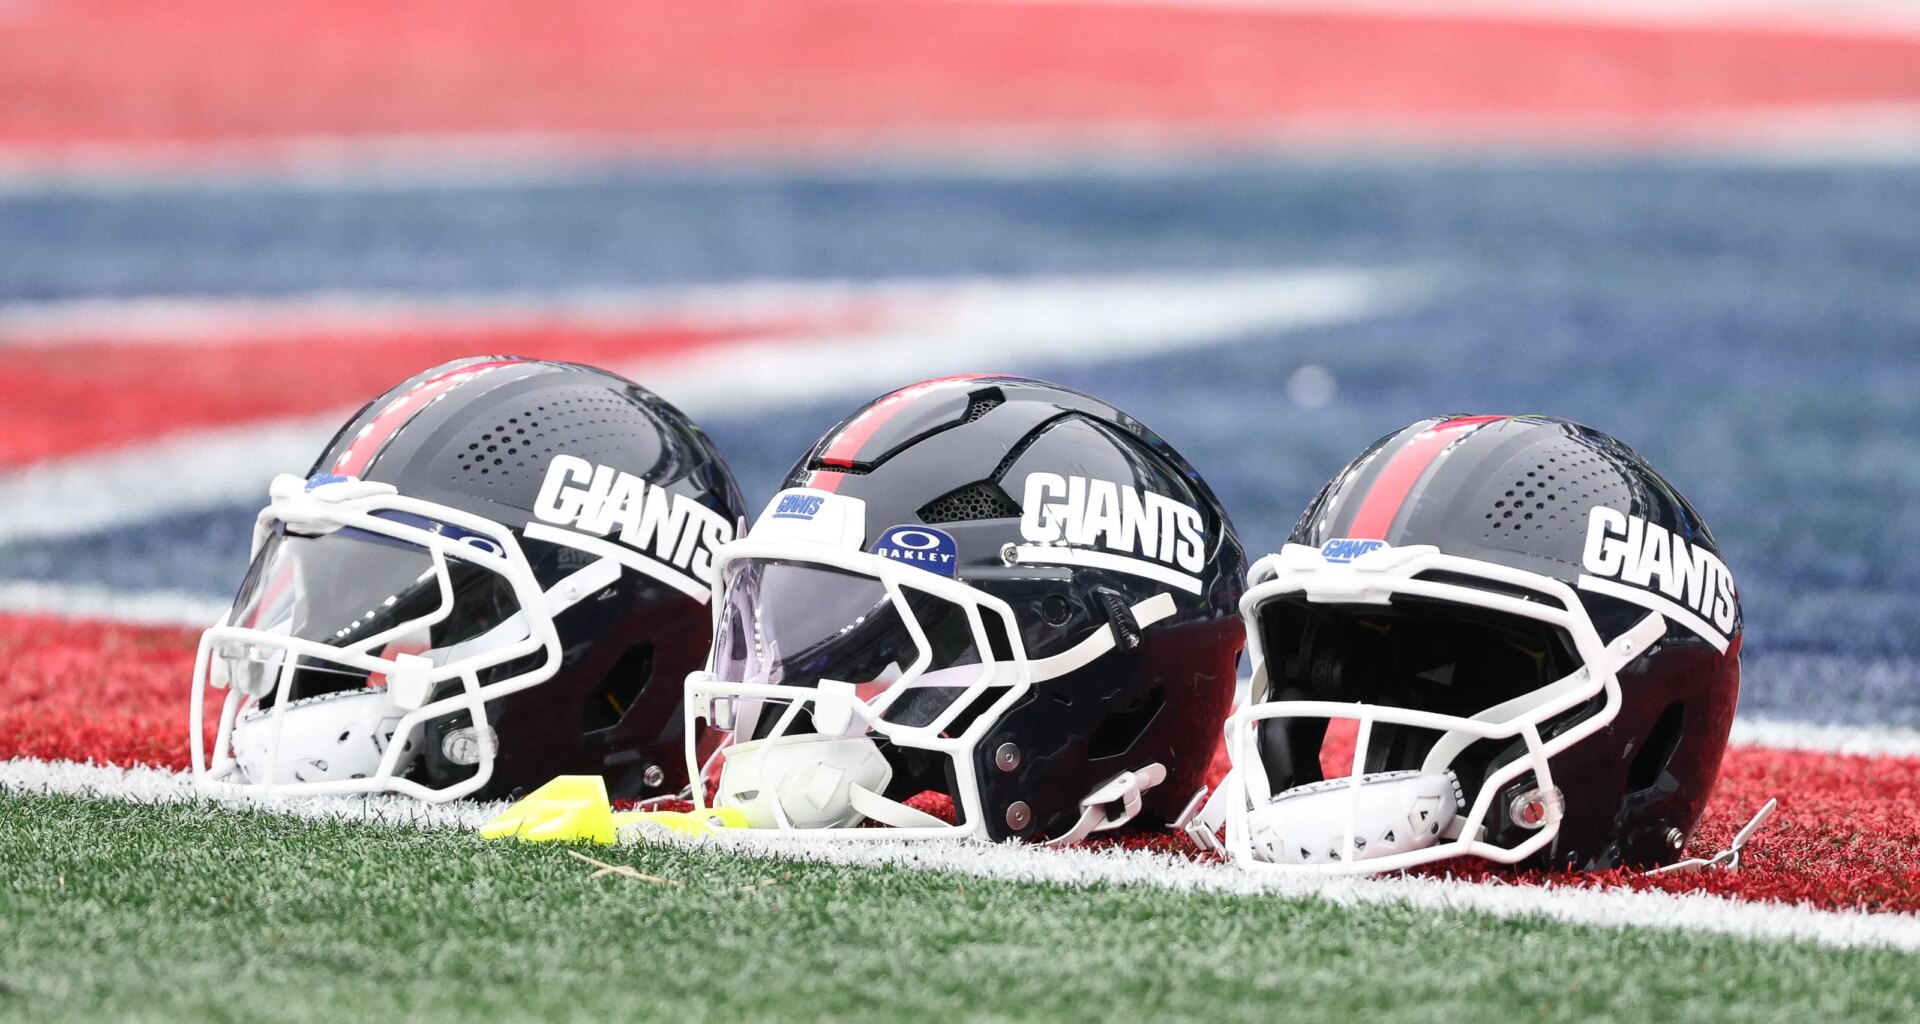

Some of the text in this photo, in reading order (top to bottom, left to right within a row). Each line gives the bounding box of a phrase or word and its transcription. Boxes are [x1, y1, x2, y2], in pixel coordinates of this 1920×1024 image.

[533, 454, 734, 586] GIANTS
[776, 494, 825, 515] GIANTS
[878, 547, 951, 563] OAKLEY
[1020, 472, 1205, 574] GIANTS
[1582, 505, 1735, 635] GIANTS
